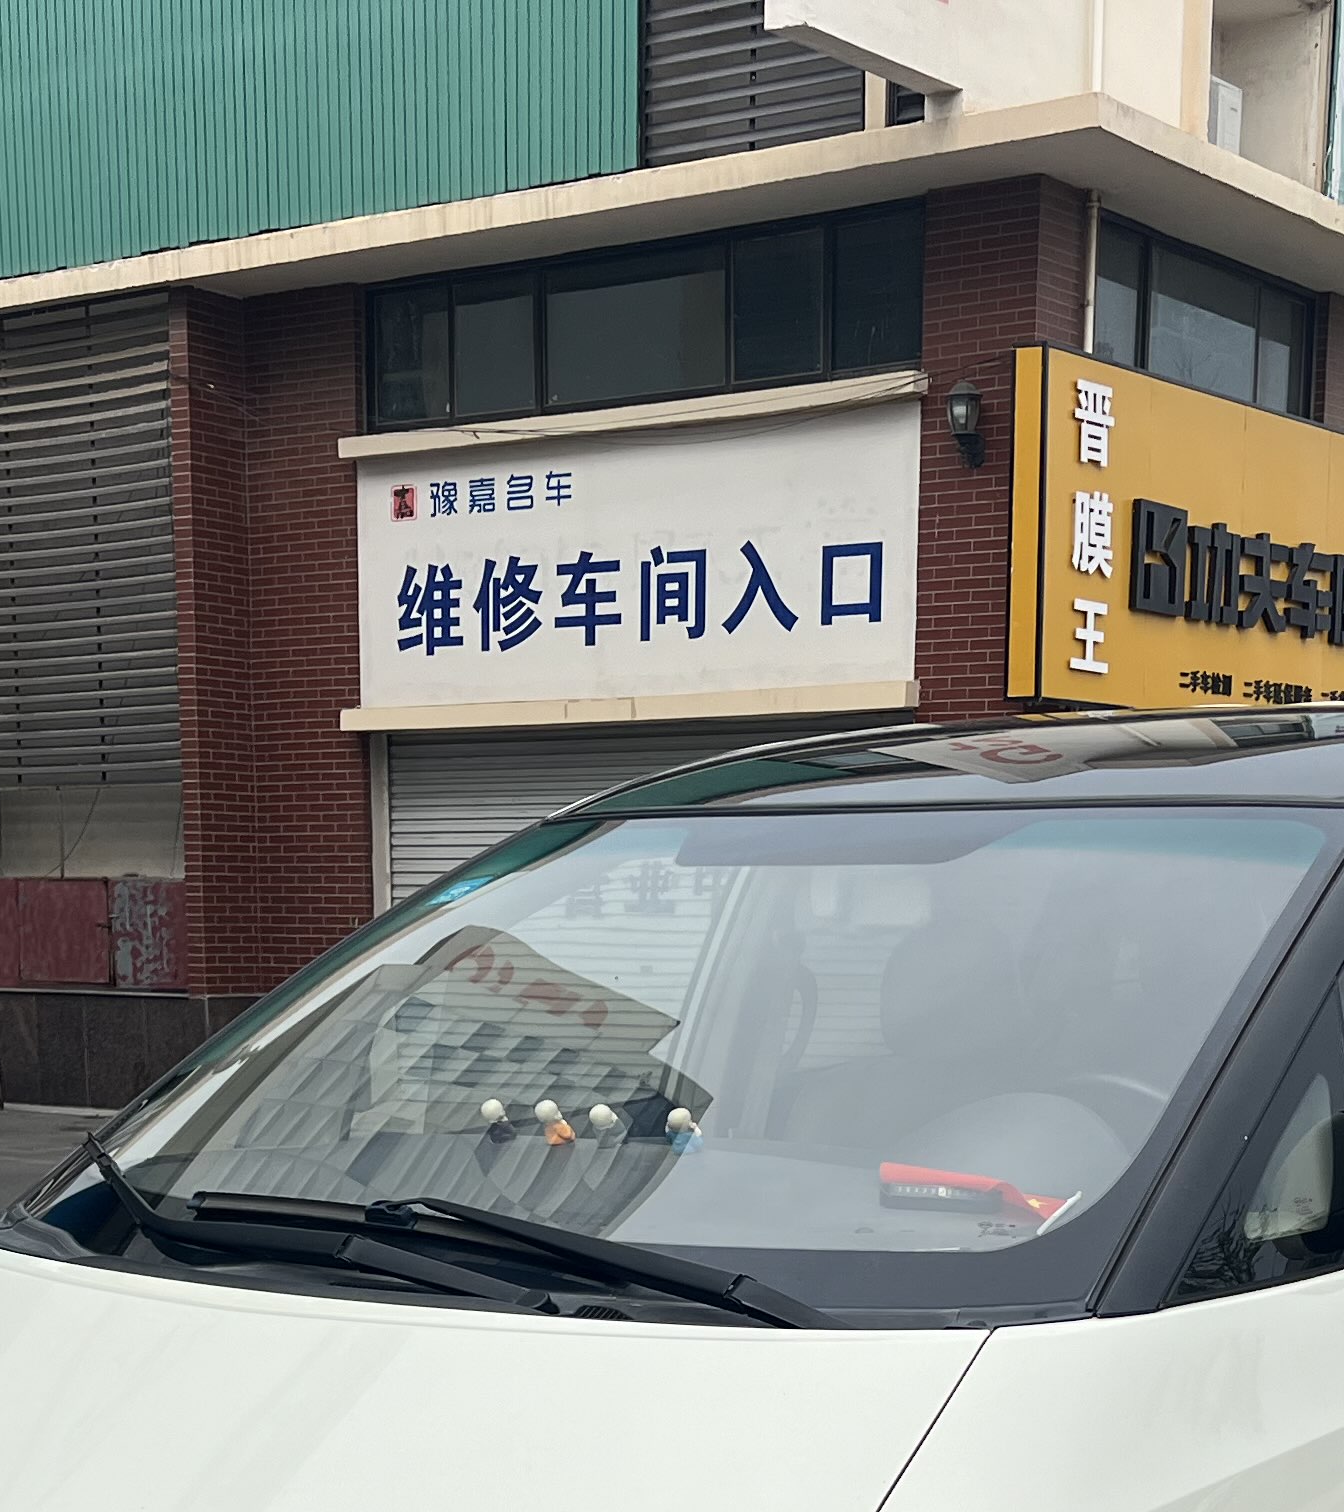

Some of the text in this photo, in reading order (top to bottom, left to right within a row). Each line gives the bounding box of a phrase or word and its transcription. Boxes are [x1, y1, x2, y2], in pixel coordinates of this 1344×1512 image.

[430, 471, 572, 517] 豫嘉名车
[1069, 378, 1115, 675] 晋膜王
[396, 540, 885, 655] 维修车间入口
